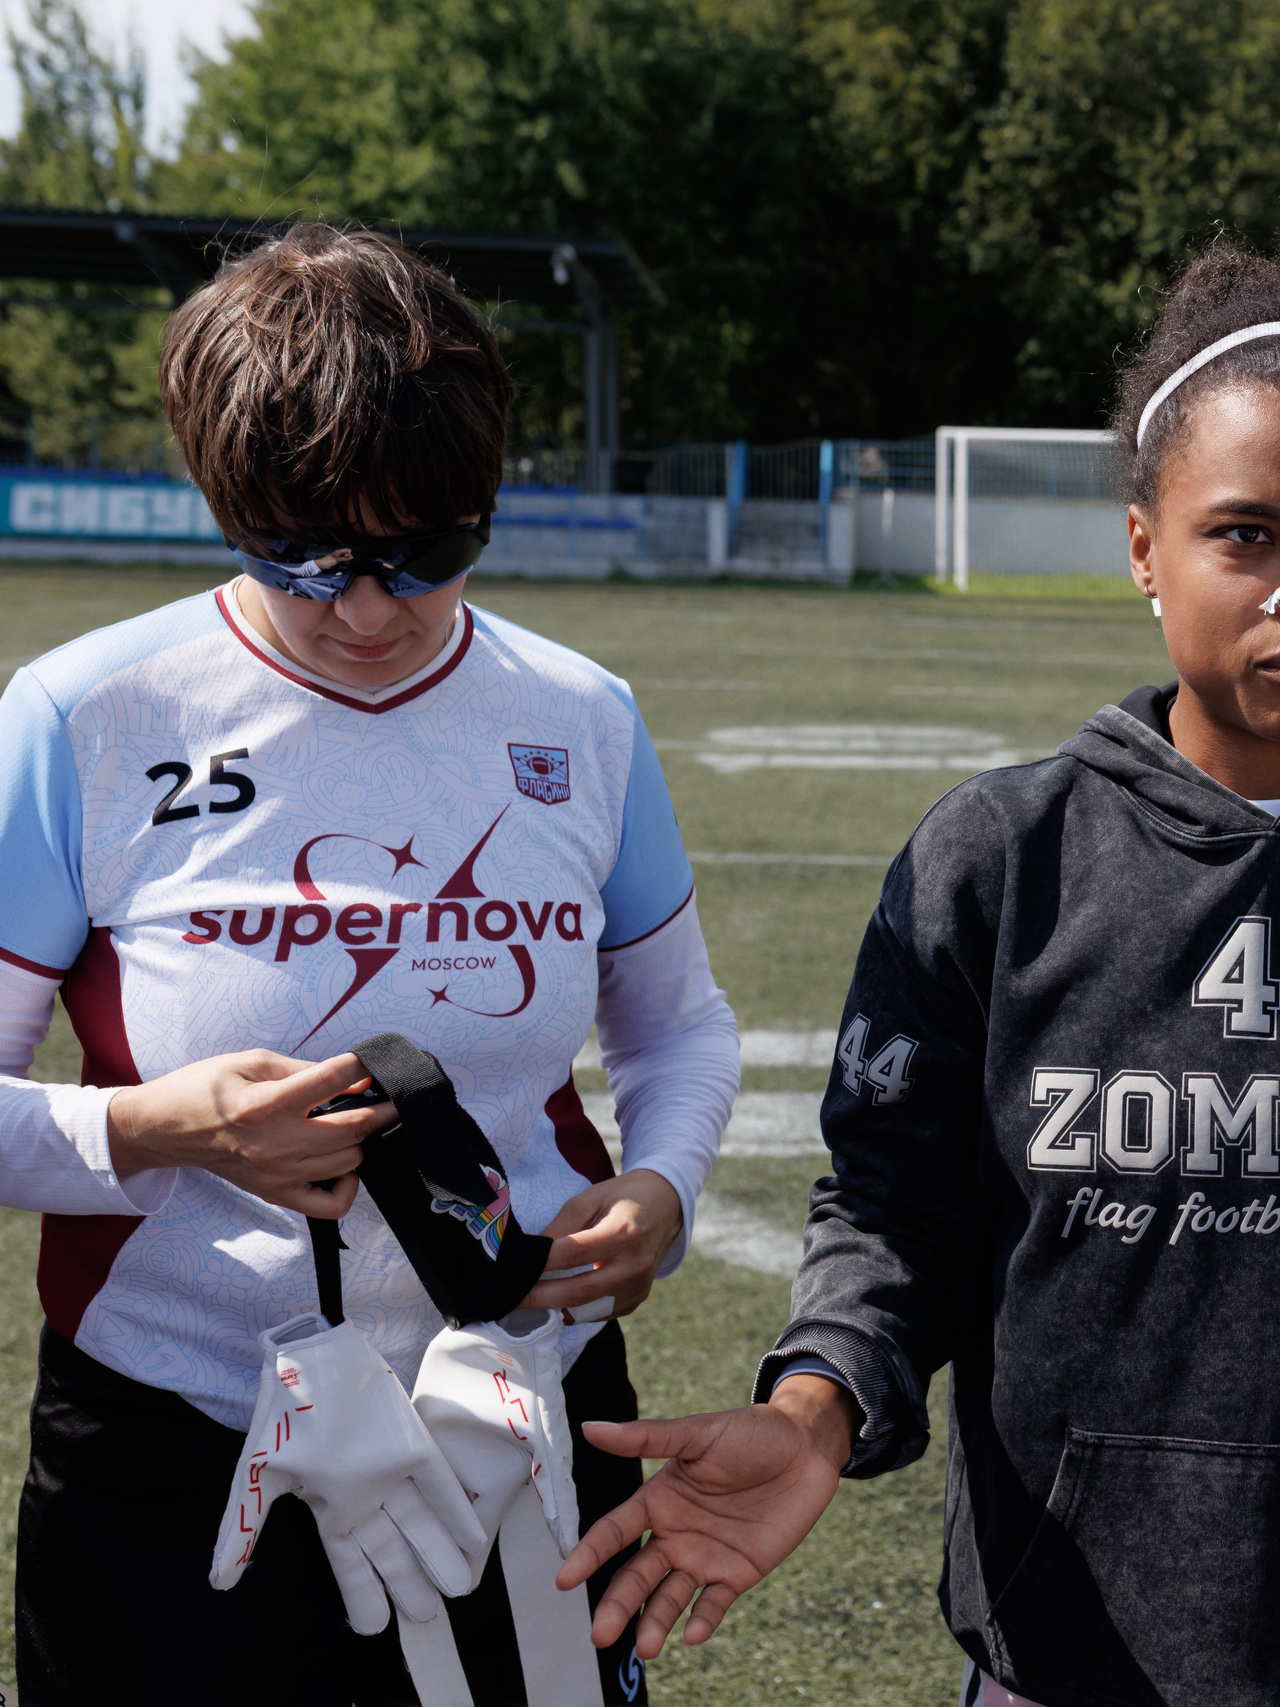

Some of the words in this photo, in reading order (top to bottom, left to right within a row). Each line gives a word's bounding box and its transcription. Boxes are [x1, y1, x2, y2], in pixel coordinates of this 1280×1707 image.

[145, 747, 256, 826] 25
[182, 901, 585, 963] supernova
[412, 956, 497, 972] MOSCOW
[837, 1013, 919, 1106] 44
[1063, 1187, 1156, 1244] flag
